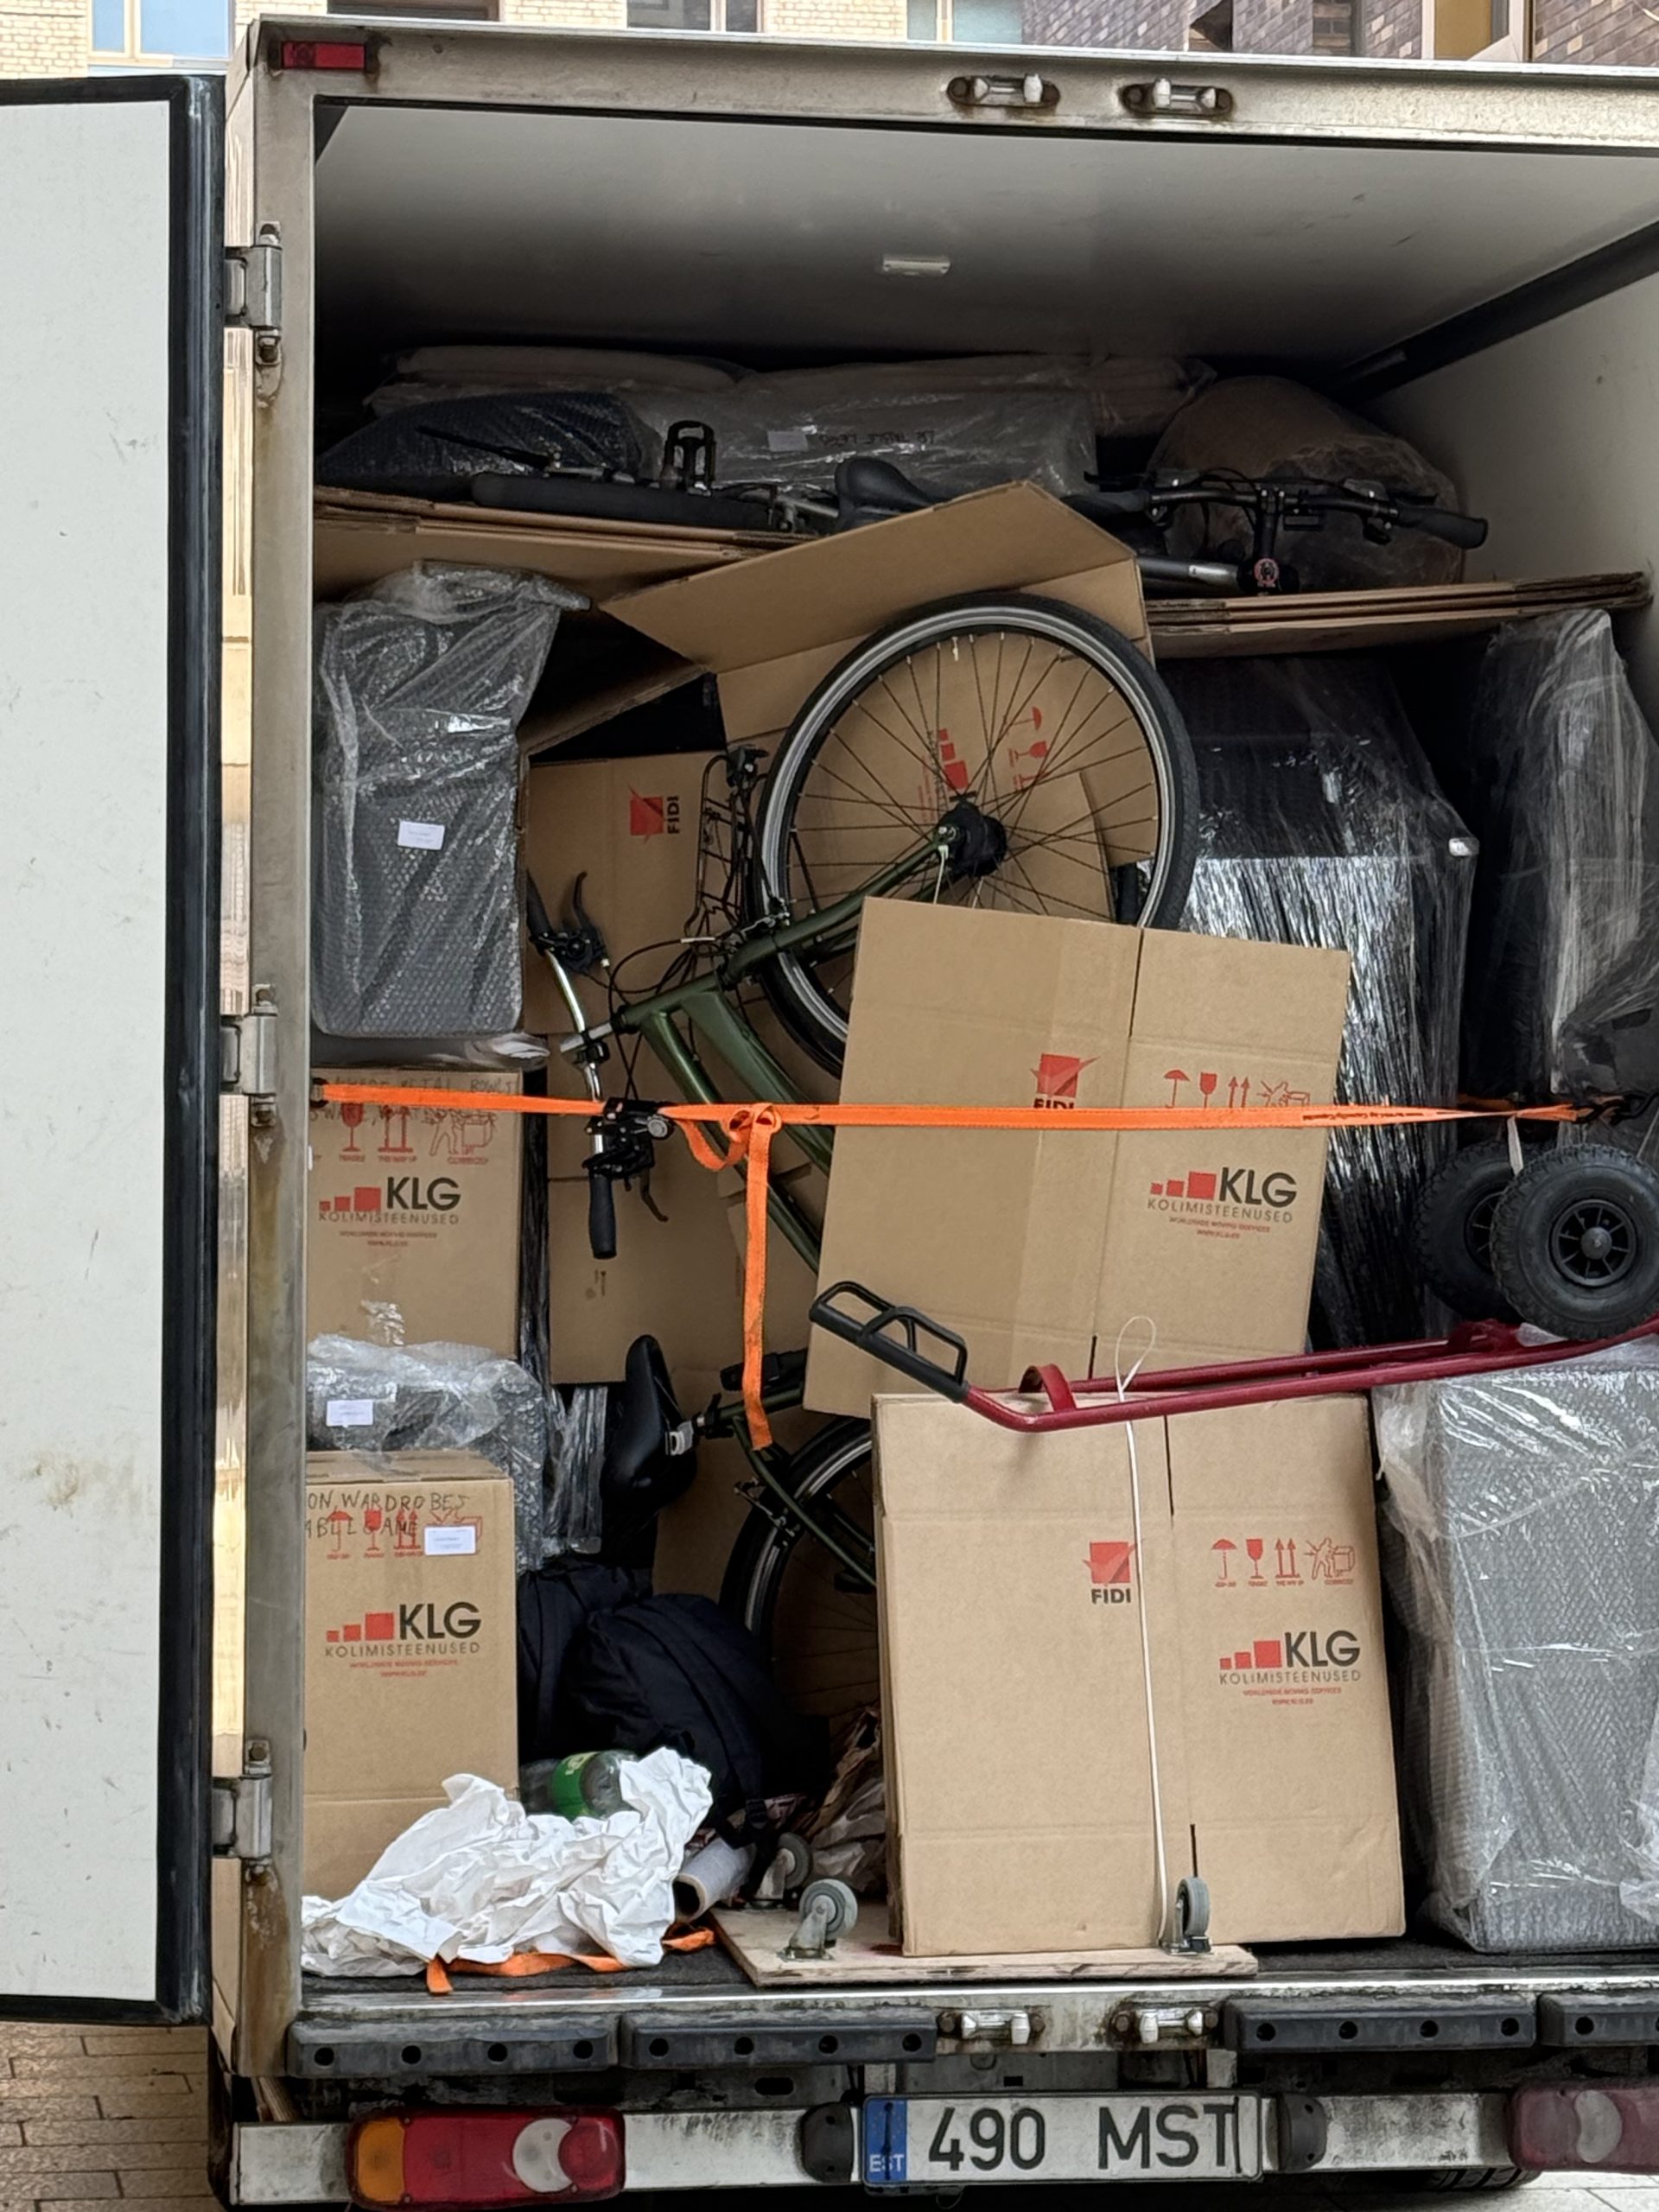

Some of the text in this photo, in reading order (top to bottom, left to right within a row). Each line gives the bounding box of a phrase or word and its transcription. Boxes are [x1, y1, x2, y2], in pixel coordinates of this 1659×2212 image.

[666, 796, 680, 834] FIDI
[386, 1176, 461, 1211] KLG
[1219, 1166, 1297, 1207] KLG
[318, 1211, 459, 1224] KOLIMISTEENUSED
[1147, 1198, 1293, 1224] KOLIMISTEENUSED
[1090, 1588, 1132, 1604] FIDI
[399, 1602, 481, 1640] KLG
[325, 1643, 480, 1658] KOLIMISTEENUSED
[1284, 1630, 1361, 1668] KLG
[1219, 1669, 1361, 1685] KOLIMISTEENUSED
[928, 2103, 1239, 2171] 490 MST
